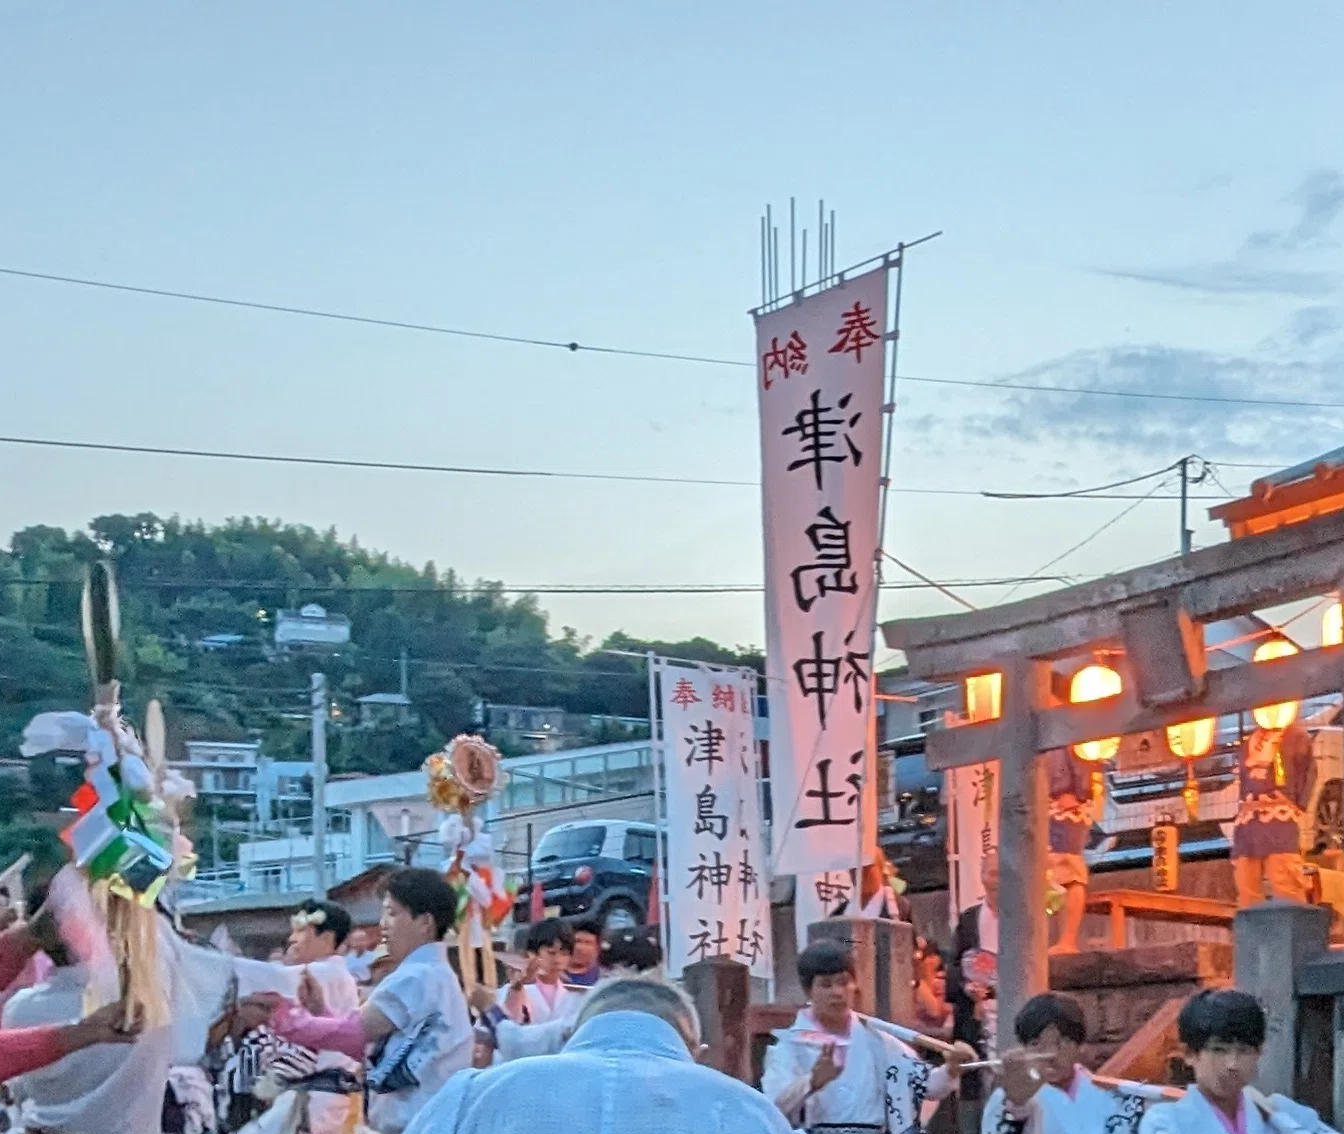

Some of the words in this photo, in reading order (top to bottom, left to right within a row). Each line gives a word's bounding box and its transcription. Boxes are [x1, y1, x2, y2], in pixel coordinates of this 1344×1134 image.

[669, 677, 737, 713] 奉納
[683, 719, 733, 959] 津島神社
